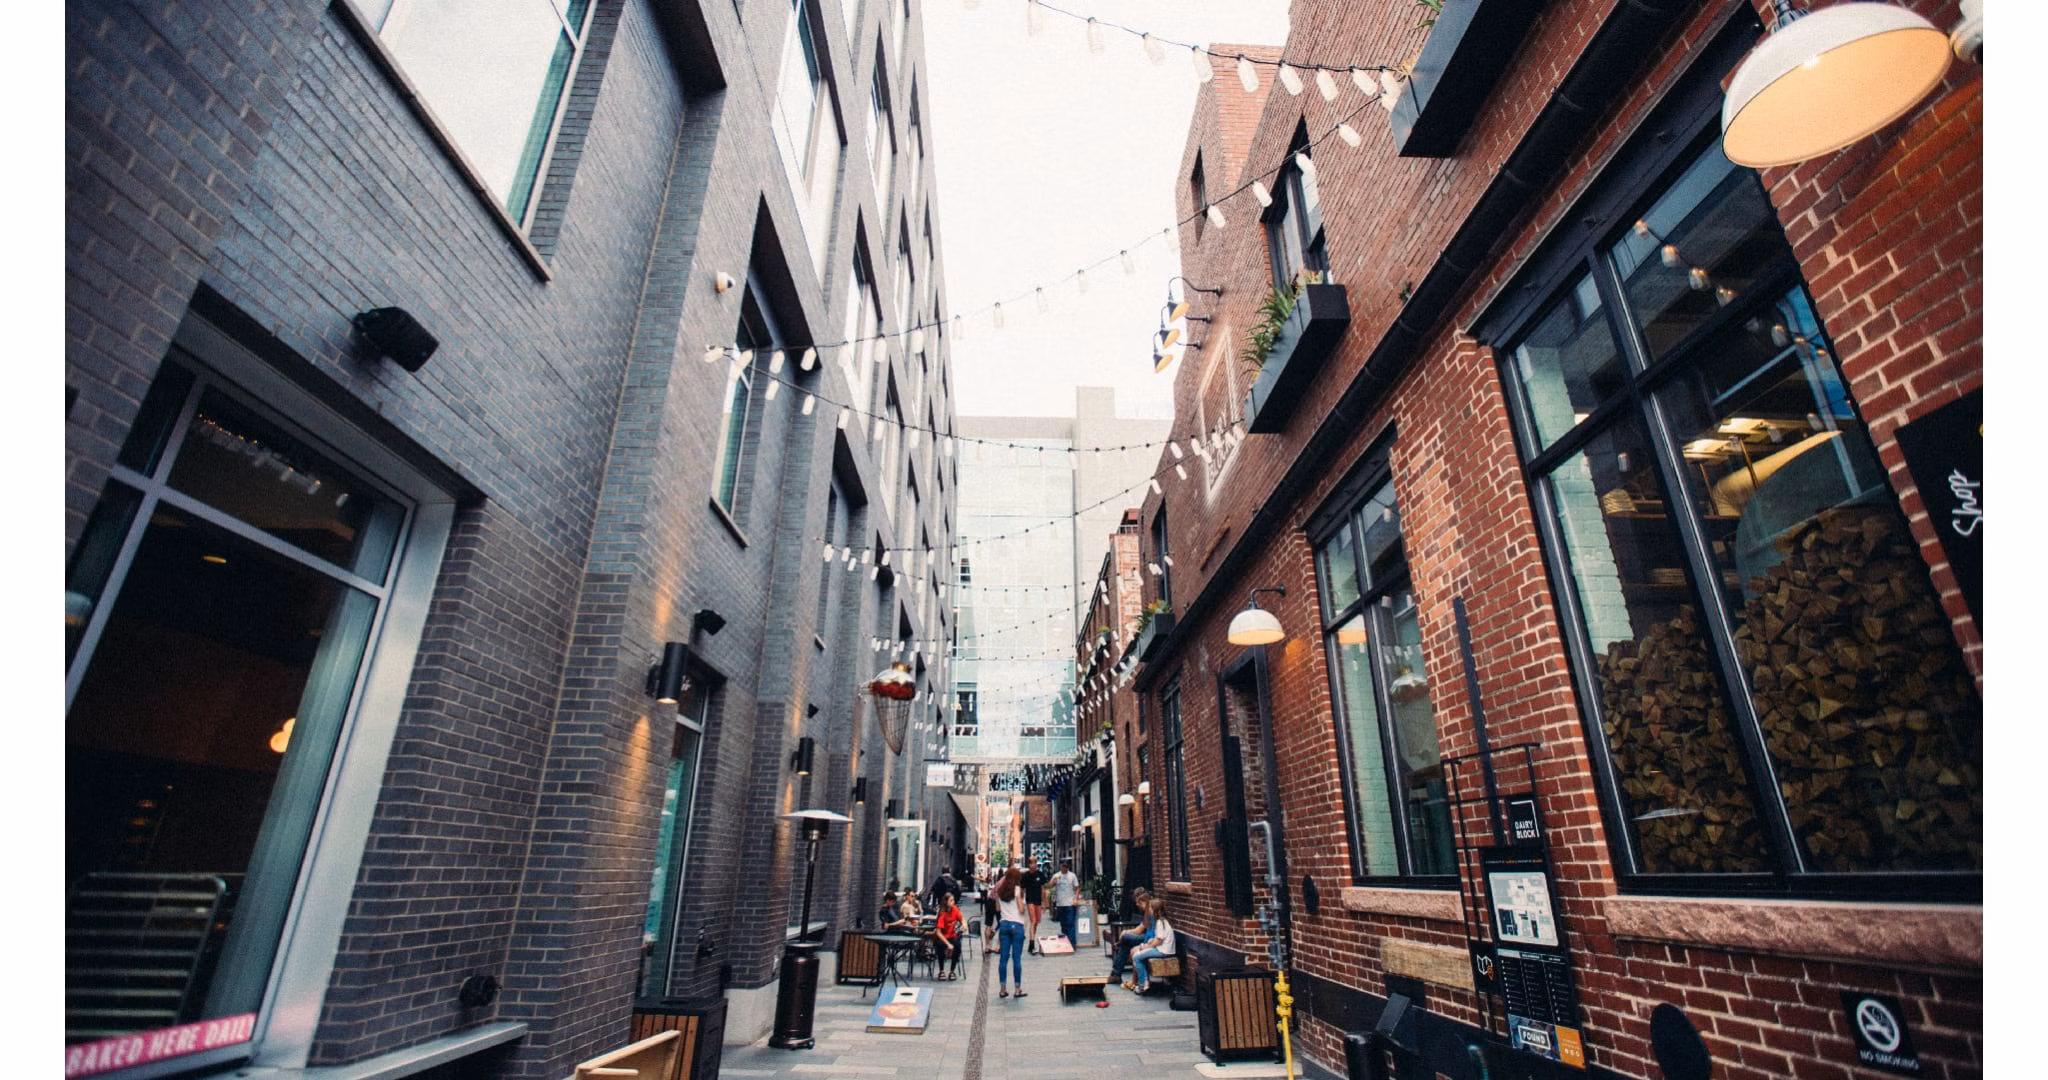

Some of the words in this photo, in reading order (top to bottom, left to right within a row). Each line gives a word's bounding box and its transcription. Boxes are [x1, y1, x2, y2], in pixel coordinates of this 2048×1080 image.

[1948, 468, 1983, 536] Shop
[1515, 820, 1533, 830] DAIRY
[1516, 829, 1537, 840] BLOCK
[1522, 1030, 1546, 1046] FOUND
[66, 1038, 144, 1075] BAKED
[149, 1027, 199, 1058] HERE
[1860, 1049, 1874, 1062] NO
[1875, 1053, 1919, 1070] SMOKING
